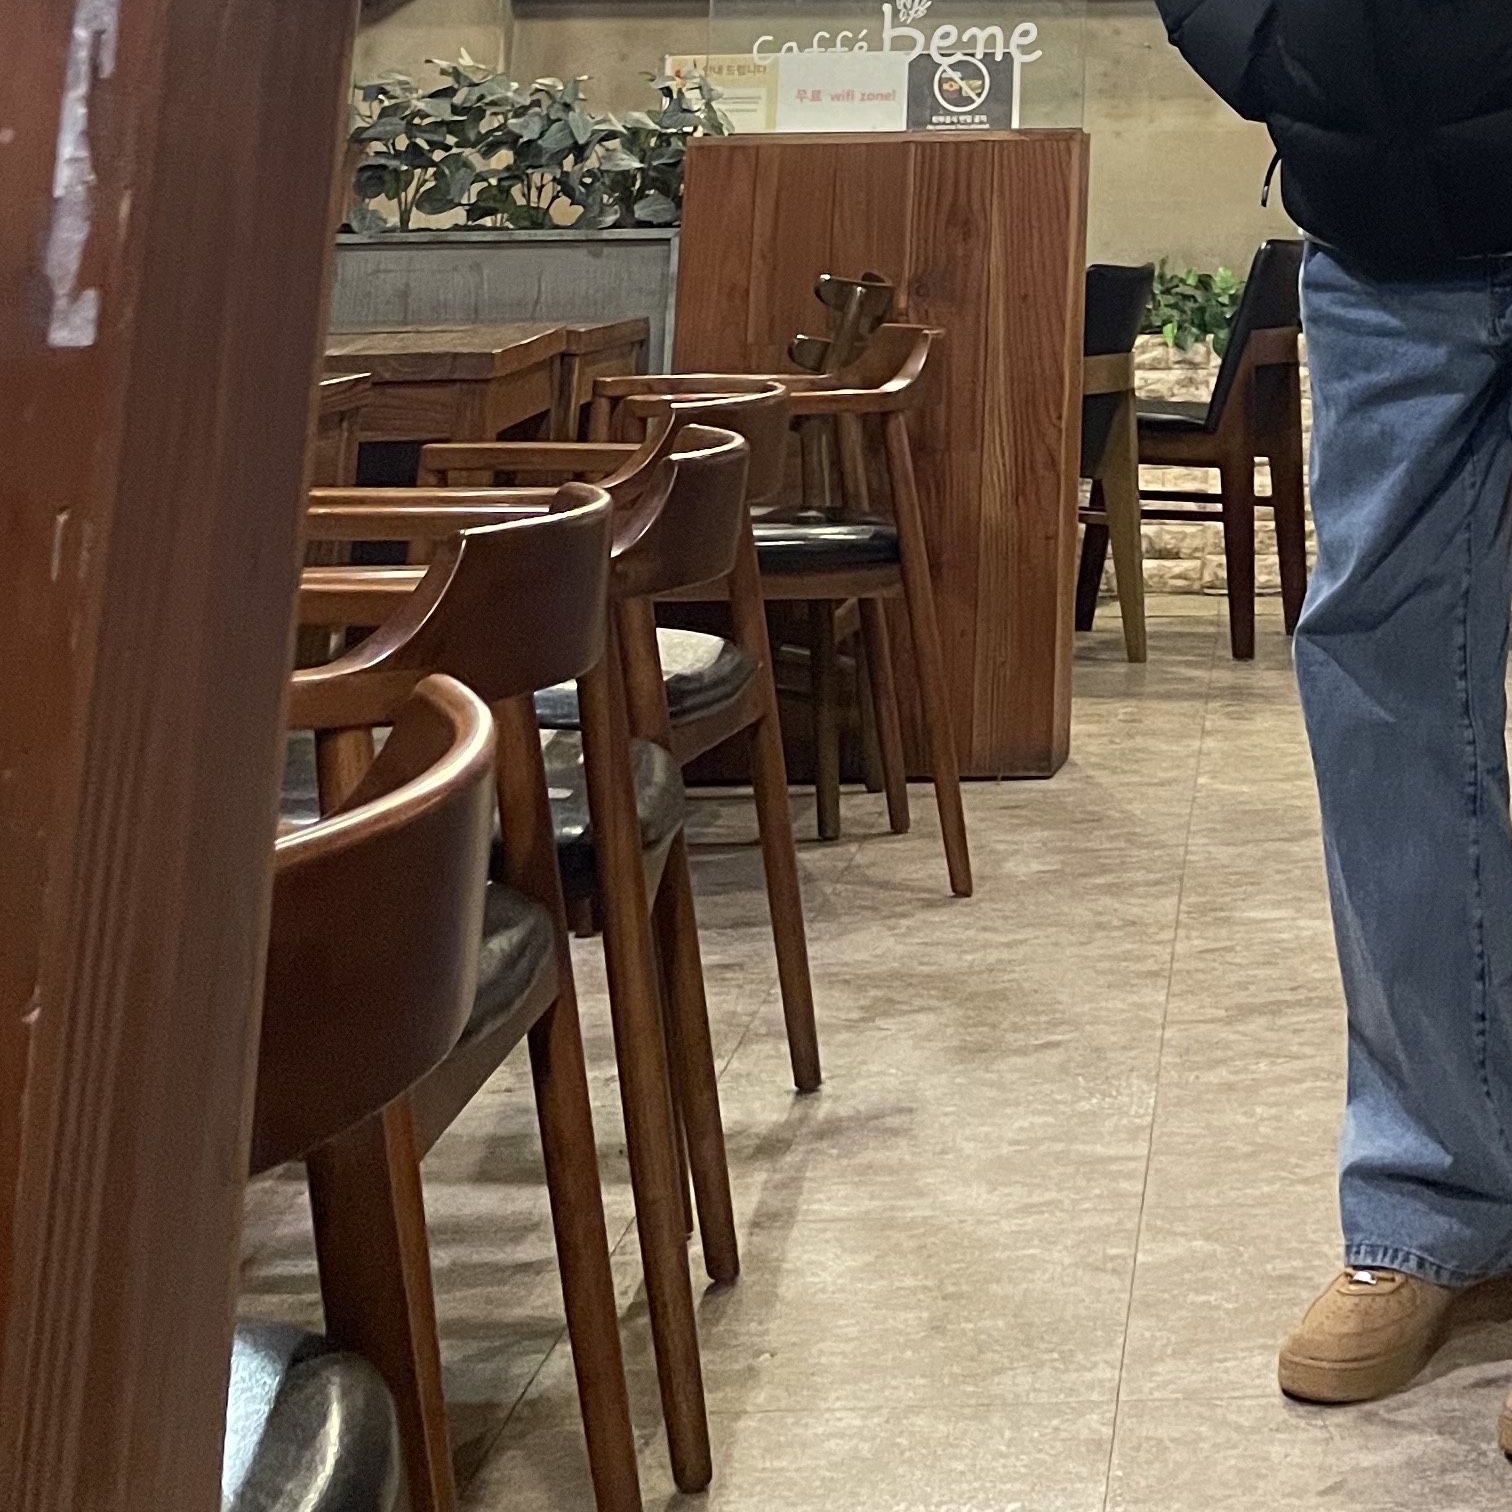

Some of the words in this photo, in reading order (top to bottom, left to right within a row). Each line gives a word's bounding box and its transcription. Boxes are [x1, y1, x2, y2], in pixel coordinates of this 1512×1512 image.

[882, 2, 1043, 65] bene
[795, 88, 822, 103] 무료
[830, 89, 855, 102] wifi
[859, 88, 897, 102] zone!
